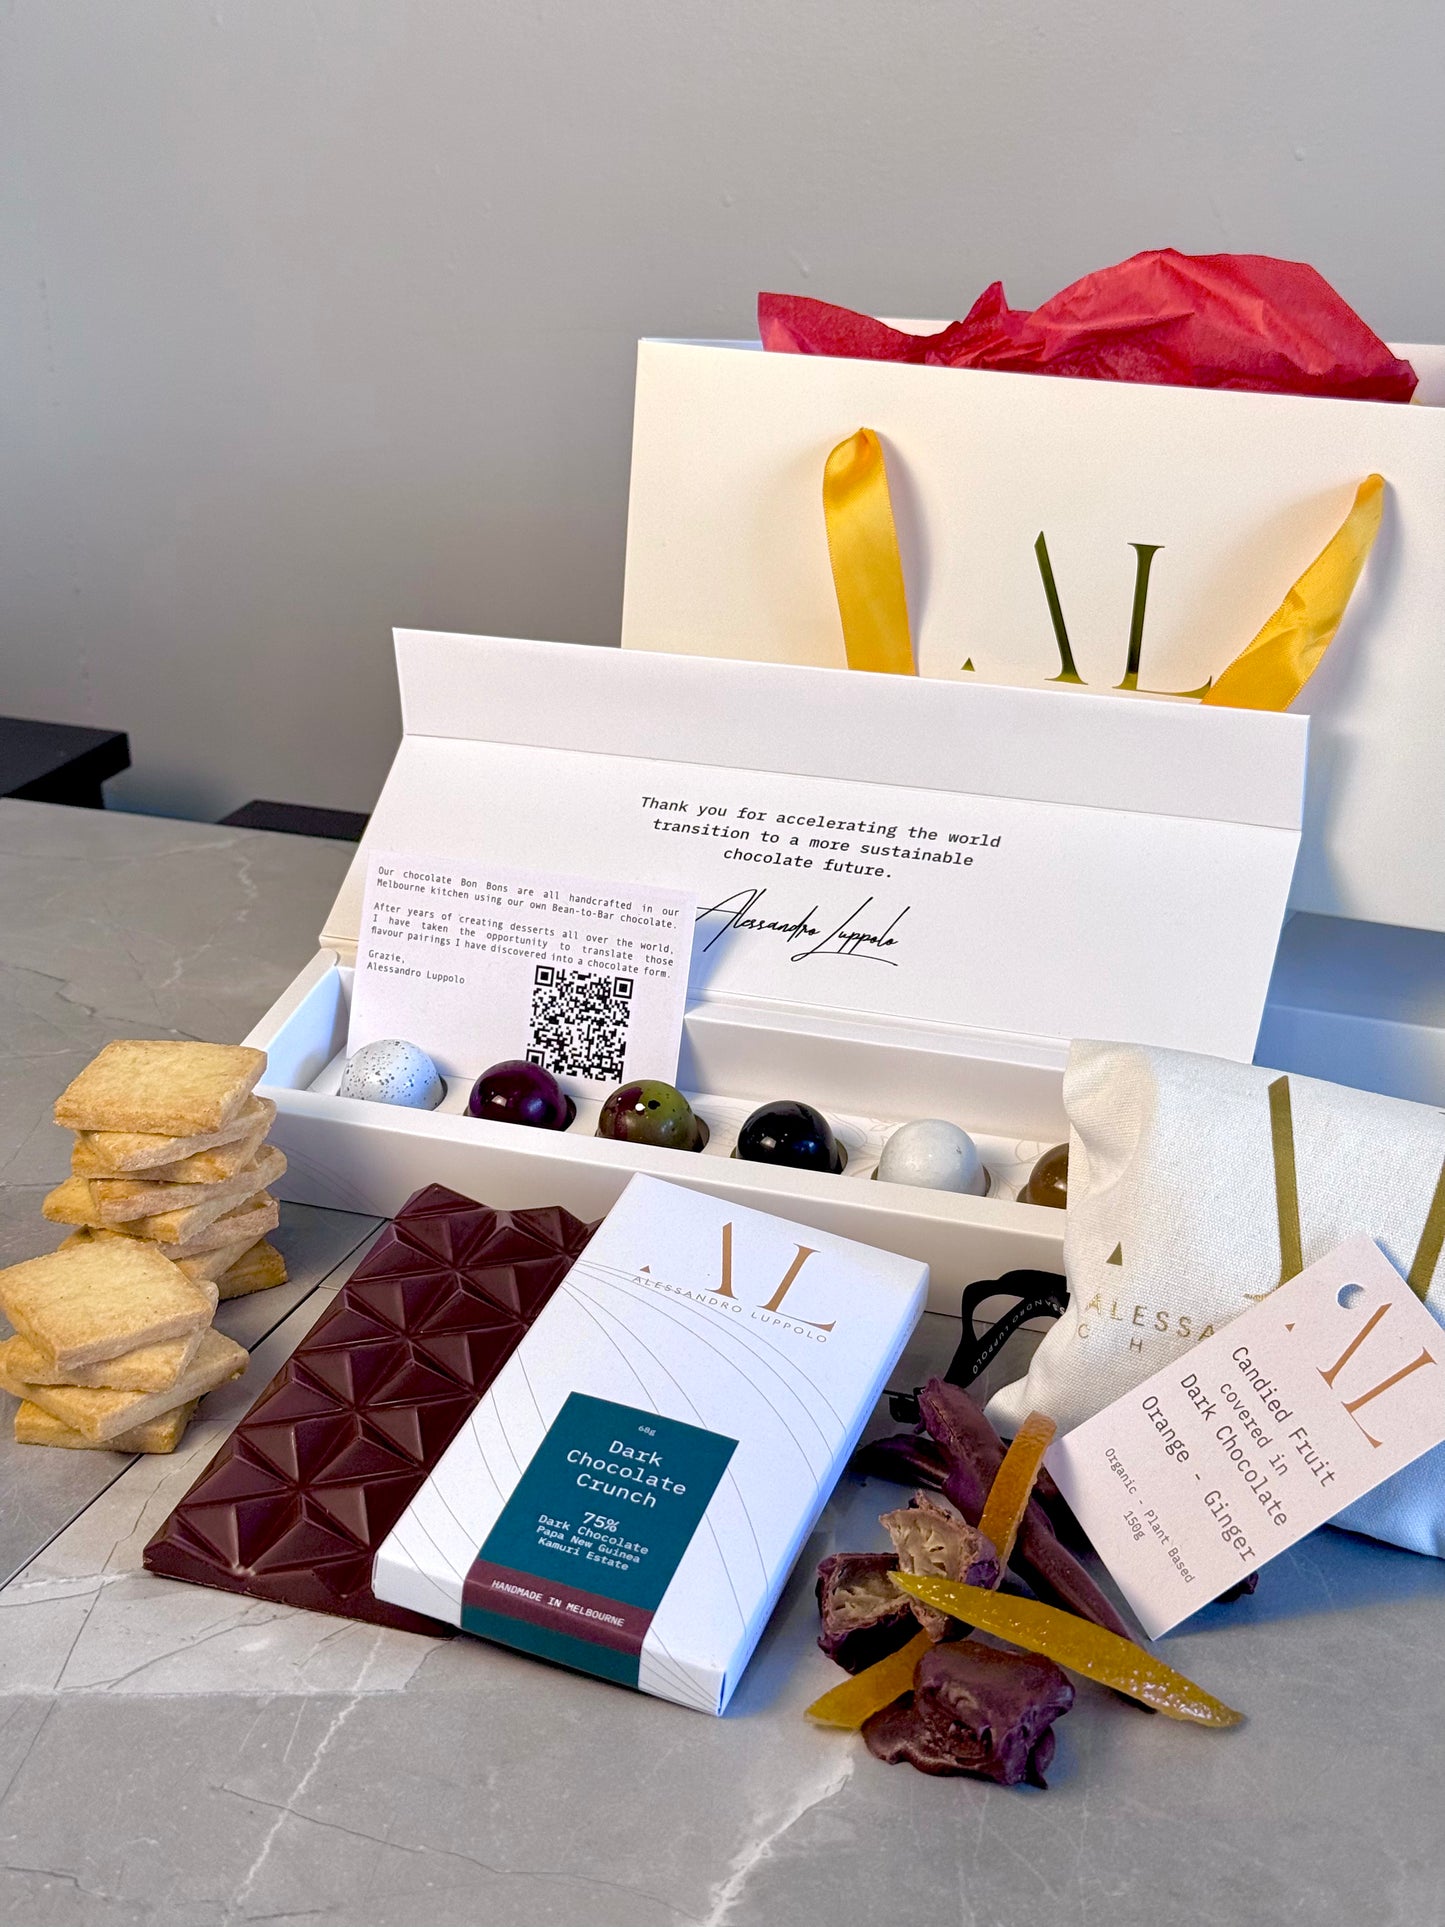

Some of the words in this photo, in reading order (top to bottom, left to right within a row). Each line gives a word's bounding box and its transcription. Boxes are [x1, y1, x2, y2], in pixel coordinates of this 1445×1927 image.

[641, 797, 689, 813] Thank
[698, 805, 727, 819] you
[737, 808, 767, 822] for
[776, 812, 897, 838] accelerating
[908, 826, 938, 841] the
[948, 832, 1001, 848] world
[653, 819, 749, 840] transition
[761, 831, 779, 844] to
[790, 835, 799, 846] a
[809, 837, 849, 851] more
[860, 841, 973, 866] sustainable
[723, 848, 813, 869] chocolate
[823, 859, 892, 878] future.
[377, 879, 425, 893] Melbourne
[431, 887, 469, 899] kitchen
[475, 894, 502, 905] using
[530, 902, 546, 910] own
[552, 904, 614, 920] Bean-to-Bar
[621, 915, 677, 929] chocolate.
[379, 866, 394, 875] Our
[403, 871, 452, 884] chocolate
[461, 878, 477, 888] Bon
[486, 882, 508, 892] Bons
[518, 887, 534, 896] are
[543, 891, 559, 899] all
[569, 894, 632, 910] handcrafted
[642, 905, 652, 913] in
[662, 908, 679, 916] our
[373, 914, 377, 922] I
[389, 917, 410, 927] have
[422, 922, 448, 932] taken
[460, 928, 475, 937] the
[486, 932, 548, 948] opportunity
[583, 946, 633, 960] translate
[646, 955, 673, 966] those
[374, 902, 401, 913] After
[408, 908, 435, 918] years
[442, 913, 453, 921] of
[459, 915, 503, 930] creating
[510, 922, 555, 936] desserts
[562, 931, 578, 940] all
[586, 935, 608, 944] over
[617, 938, 633, 948] the
[695, 888, 820, 952] Alessandro
[791, 897, 910, 966] Luppolo
[367, 962, 421, 977] Alessandro
[427, 971, 465, 984] Luppolo
[369, 950, 405, 964] Grazie,
[372, 926, 403, 938] flavour
[408, 933, 450, 946] pairings
[465, 941, 486, 951] have
[490, 945, 547, 960] discovered
[552, 954, 573, 964] into
[588, 959, 638, 973] chocolate
[644, 967, 670, 978] form.
[632, 1276, 742, 1314] ALESSANDRO
[751, 1311, 827, 1344] LUPPOLO
[638, 1425, 656, 1436] 68g
[1219, 1382, 1275, 1449] covered
[1268, 1454, 1289, 1477] in
[1231, 1346, 1292, 1424] Candied
[1287, 1425, 1338, 1488] Fruit
[566, 1449, 686, 1496] Chocolate
[609, 1440, 664, 1467] Dark
[1179, 1373, 1218, 1421] Dark
[1215, 1424, 1288, 1527] Chocolate
[576, 1473, 657, 1508] Crunch
[1140, 1395, 1192, 1464] Orange
[1203, 1490, 1257, 1562] Ginger
[538, 1514, 570, 1531] Dark
[577, 1526, 648, 1555] Chocolate
[583, 1511, 620, 1532] 75%
[1104, 1446, 1136, 1495] Organic
[1143, 1509, 1171, 1546] Plant
[1167, 1545, 1196, 1584] Based
[1122, 1510, 1146, 1543] 150g
[536, 1526, 564, 1540] Papa
[570, 1535, 592, 1549] New
[598, 1542, 640, 1563] Guinea
[538, 1537, 579, 1556] Kamuri
[587, 1551, 629, 1571] Estate
[491, 1580, 542, 1601] HANDMADE
[549, 1597, 561, 1607] IN
[566, 1603, 625, 1626] MELBOURNE
